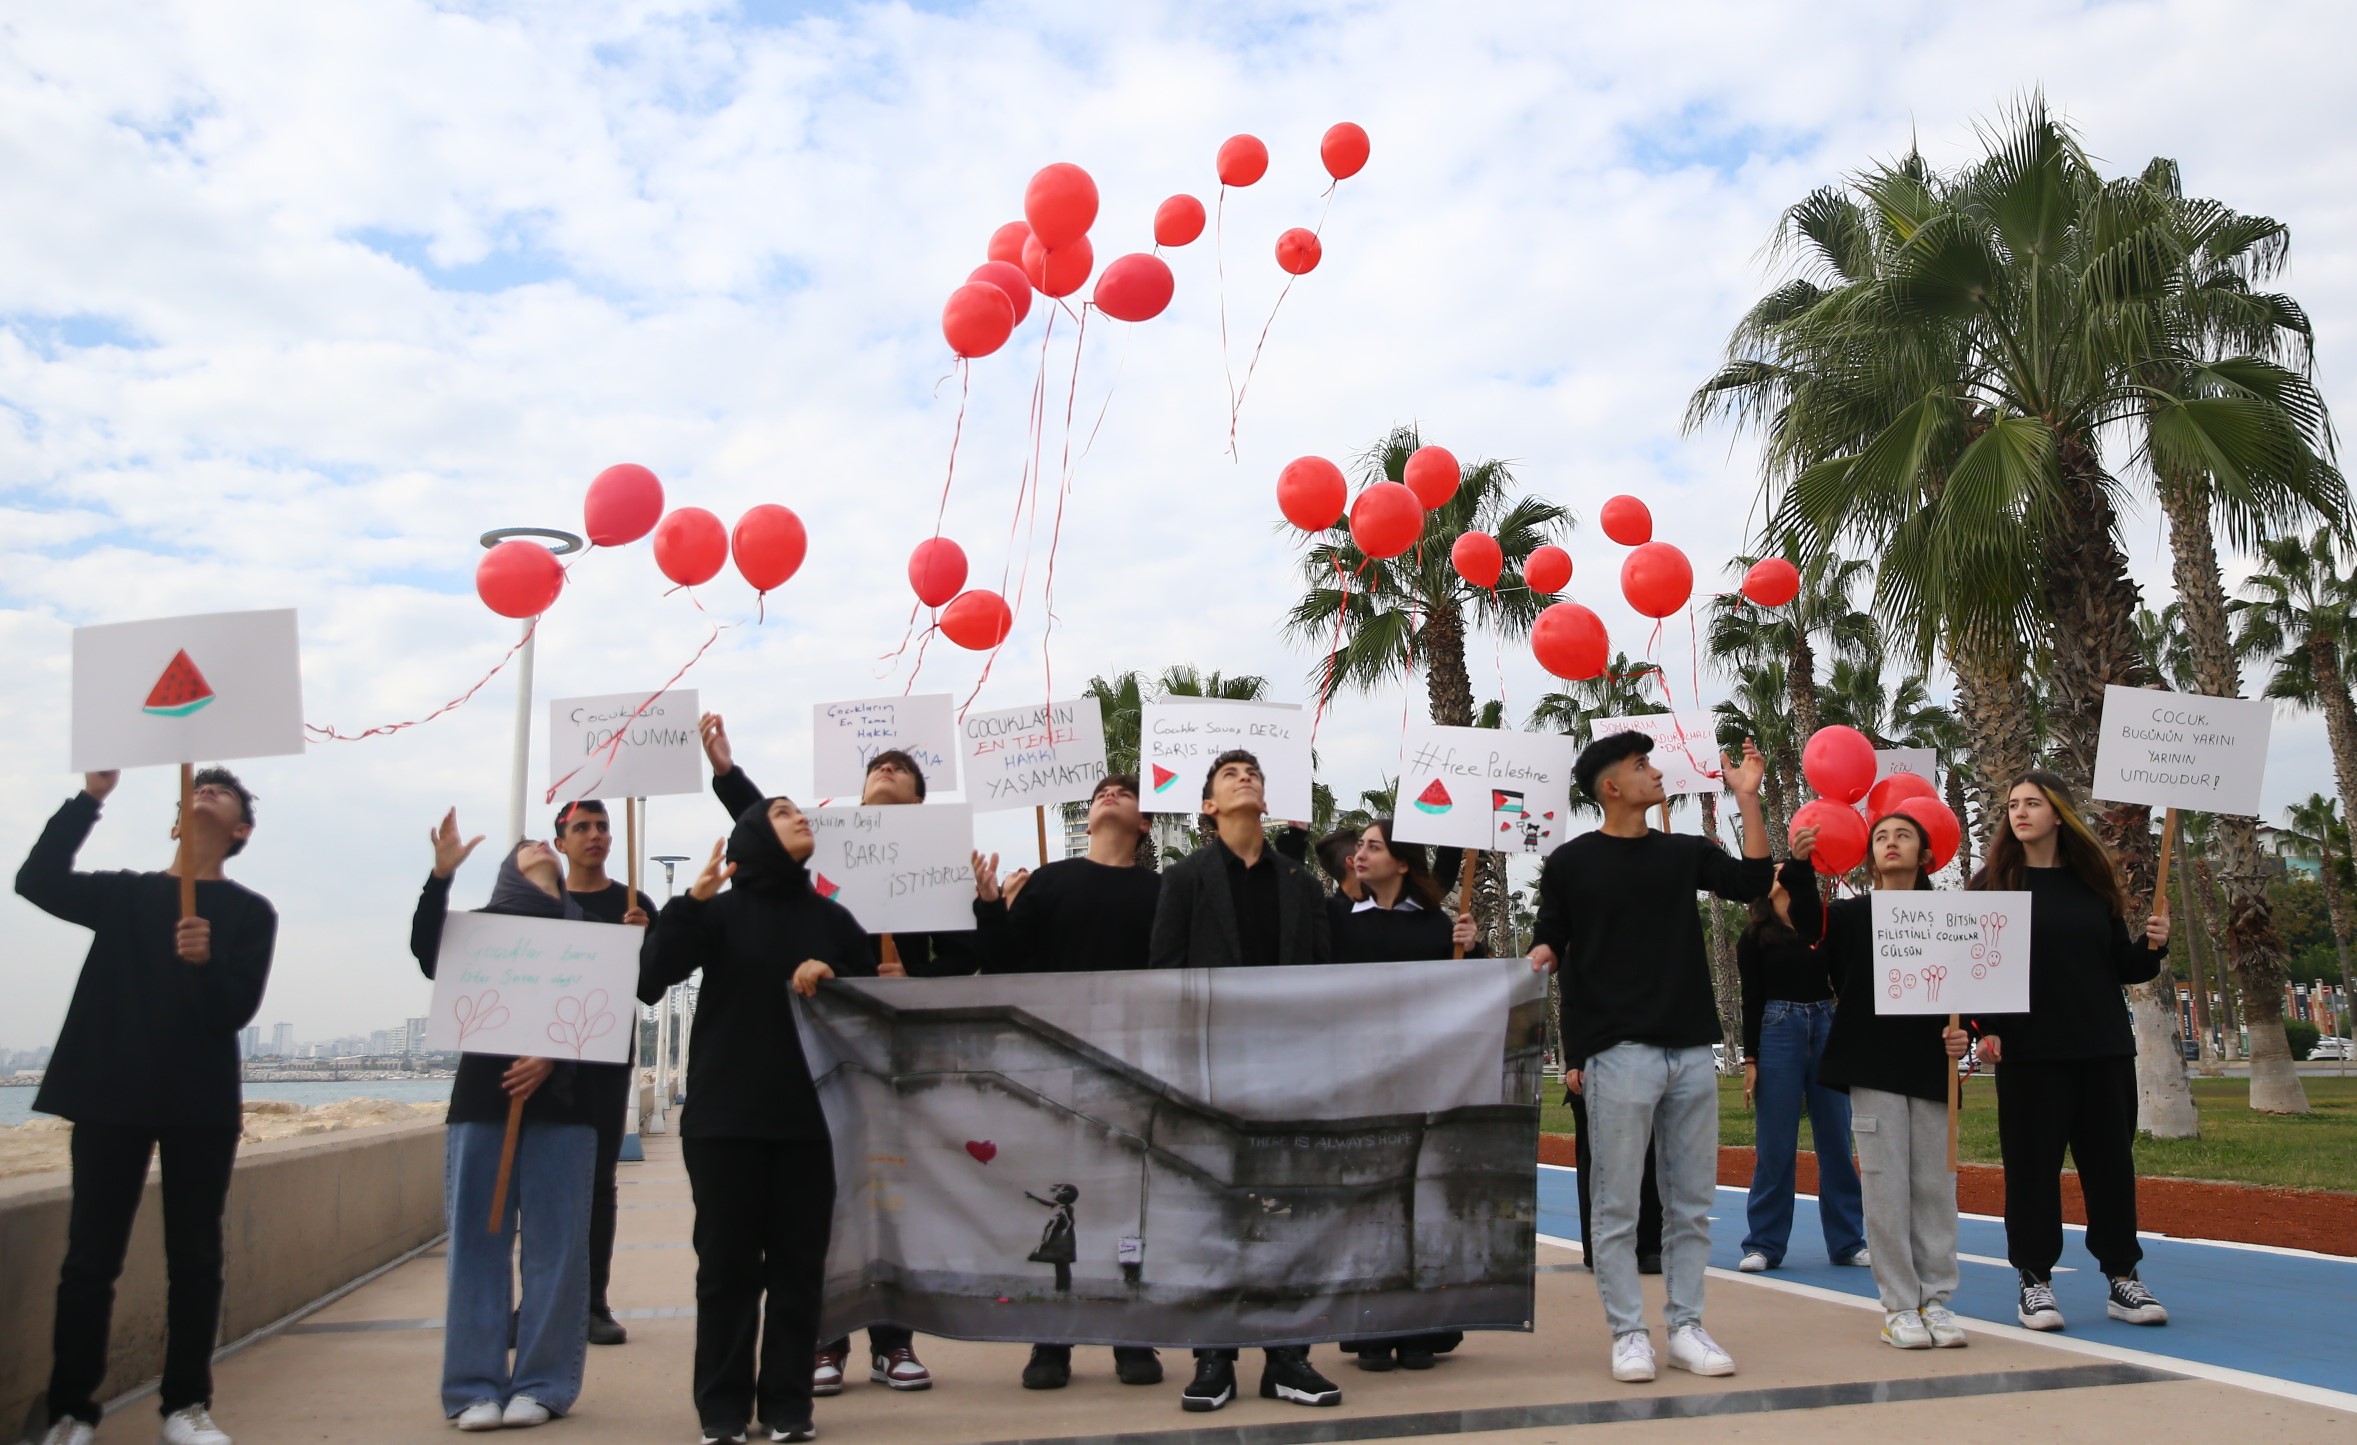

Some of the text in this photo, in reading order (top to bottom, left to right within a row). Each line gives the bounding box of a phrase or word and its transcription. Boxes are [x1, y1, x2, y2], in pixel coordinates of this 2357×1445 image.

[839, 714, 895, 727] En Temel
[973, 727, 1080, 756] EN TEMEL
[2192, 733, 2235, 747] YARINI
[1004, 748, 1057, 770] HAKKI
[1487, 751, 1550, 783] Palestine
[2147, 749, 2196, 765] YARININ
[986, 760, 1107, 799] YAŞAMAKTIR
[844, 839, 900, 870] BARIŞ
[1891, 906, 1934, 928] SAVAŞ
[1880, 944, 1922, 958] GÜLSÜN
[1294, 1136, 1310, 1148] IS
